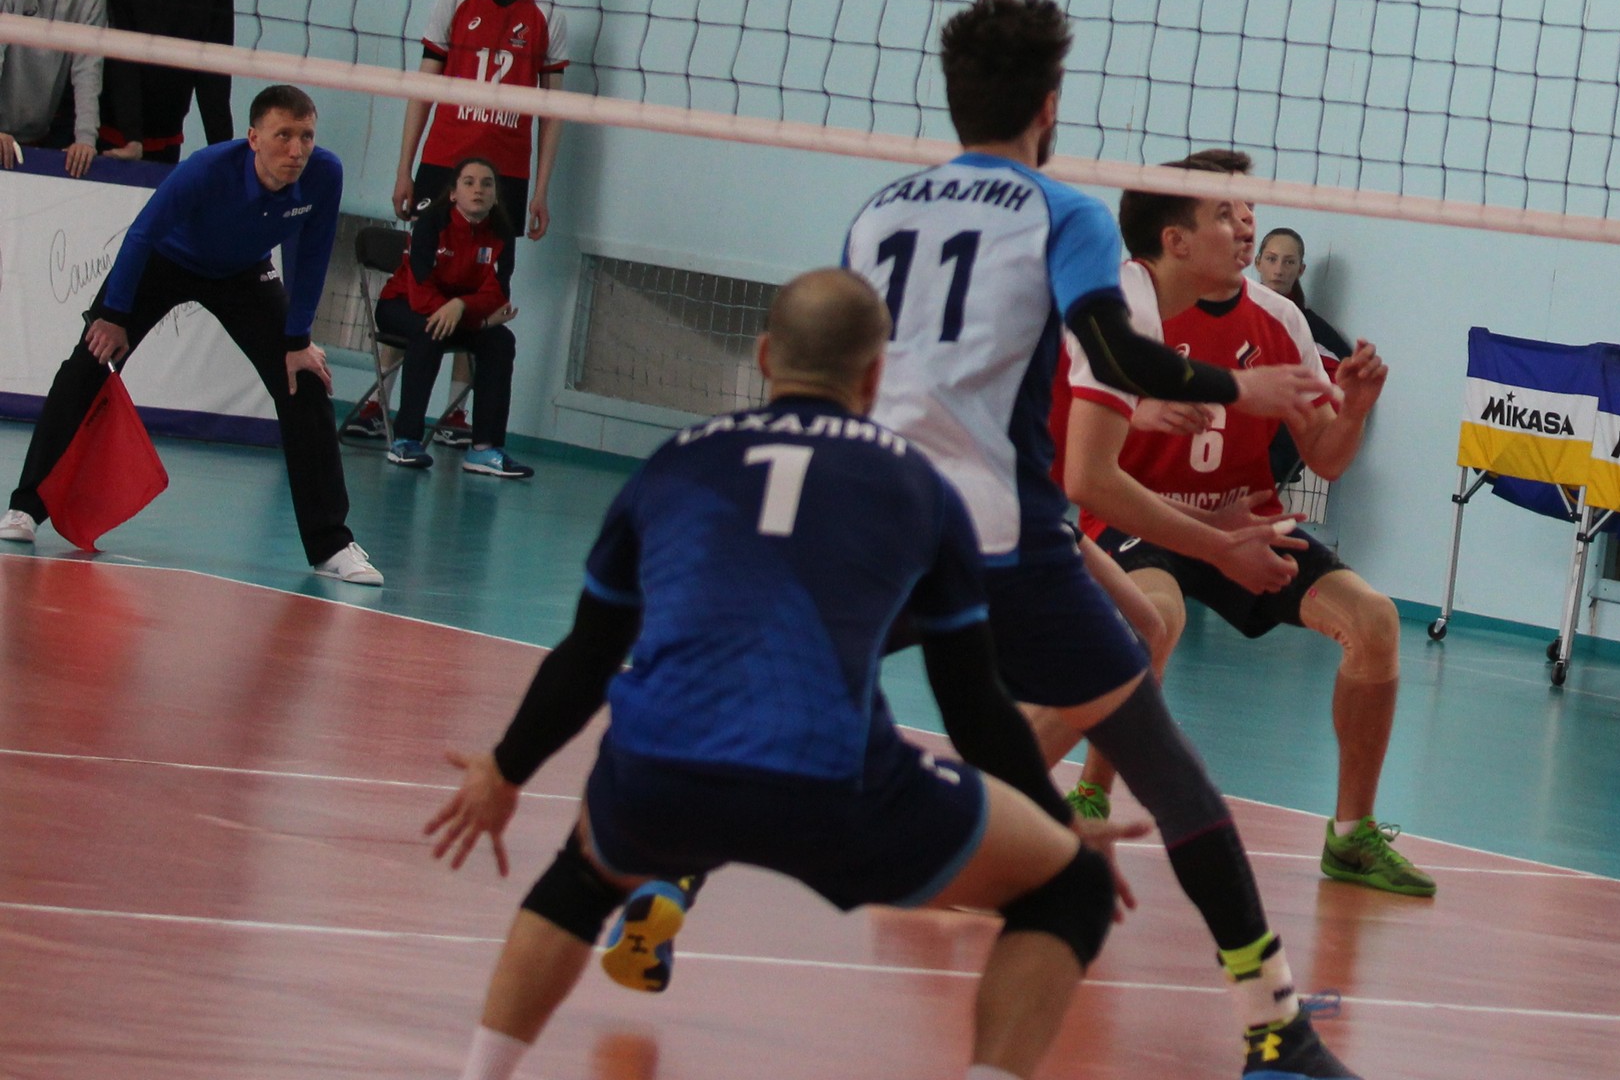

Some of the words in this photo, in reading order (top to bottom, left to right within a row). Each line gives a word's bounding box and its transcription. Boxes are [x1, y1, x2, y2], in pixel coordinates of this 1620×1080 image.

[476, 47, 514, 85] 12
[876, 229, 983, 343] 11
[742, 442, 815, 538] 1
